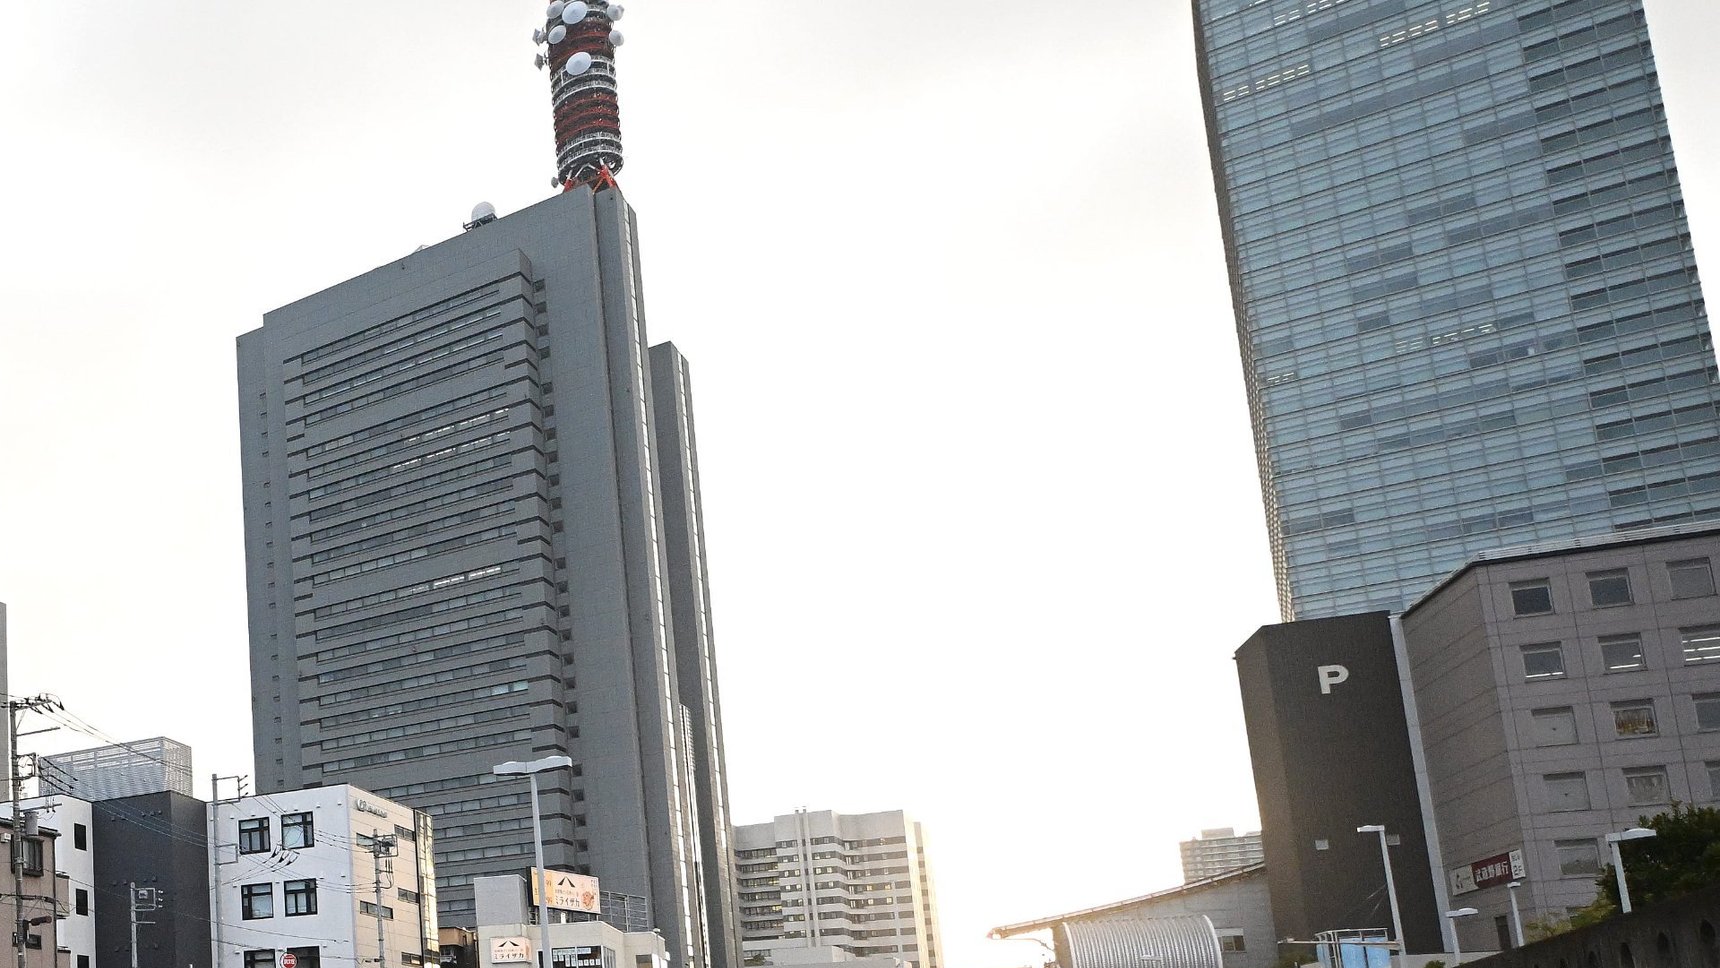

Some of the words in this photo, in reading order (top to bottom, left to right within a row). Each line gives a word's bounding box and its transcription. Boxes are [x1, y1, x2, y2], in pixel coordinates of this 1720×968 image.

[1317, 664, 1349, 694] P
[494, 952, 524, 960] ミライザカ
